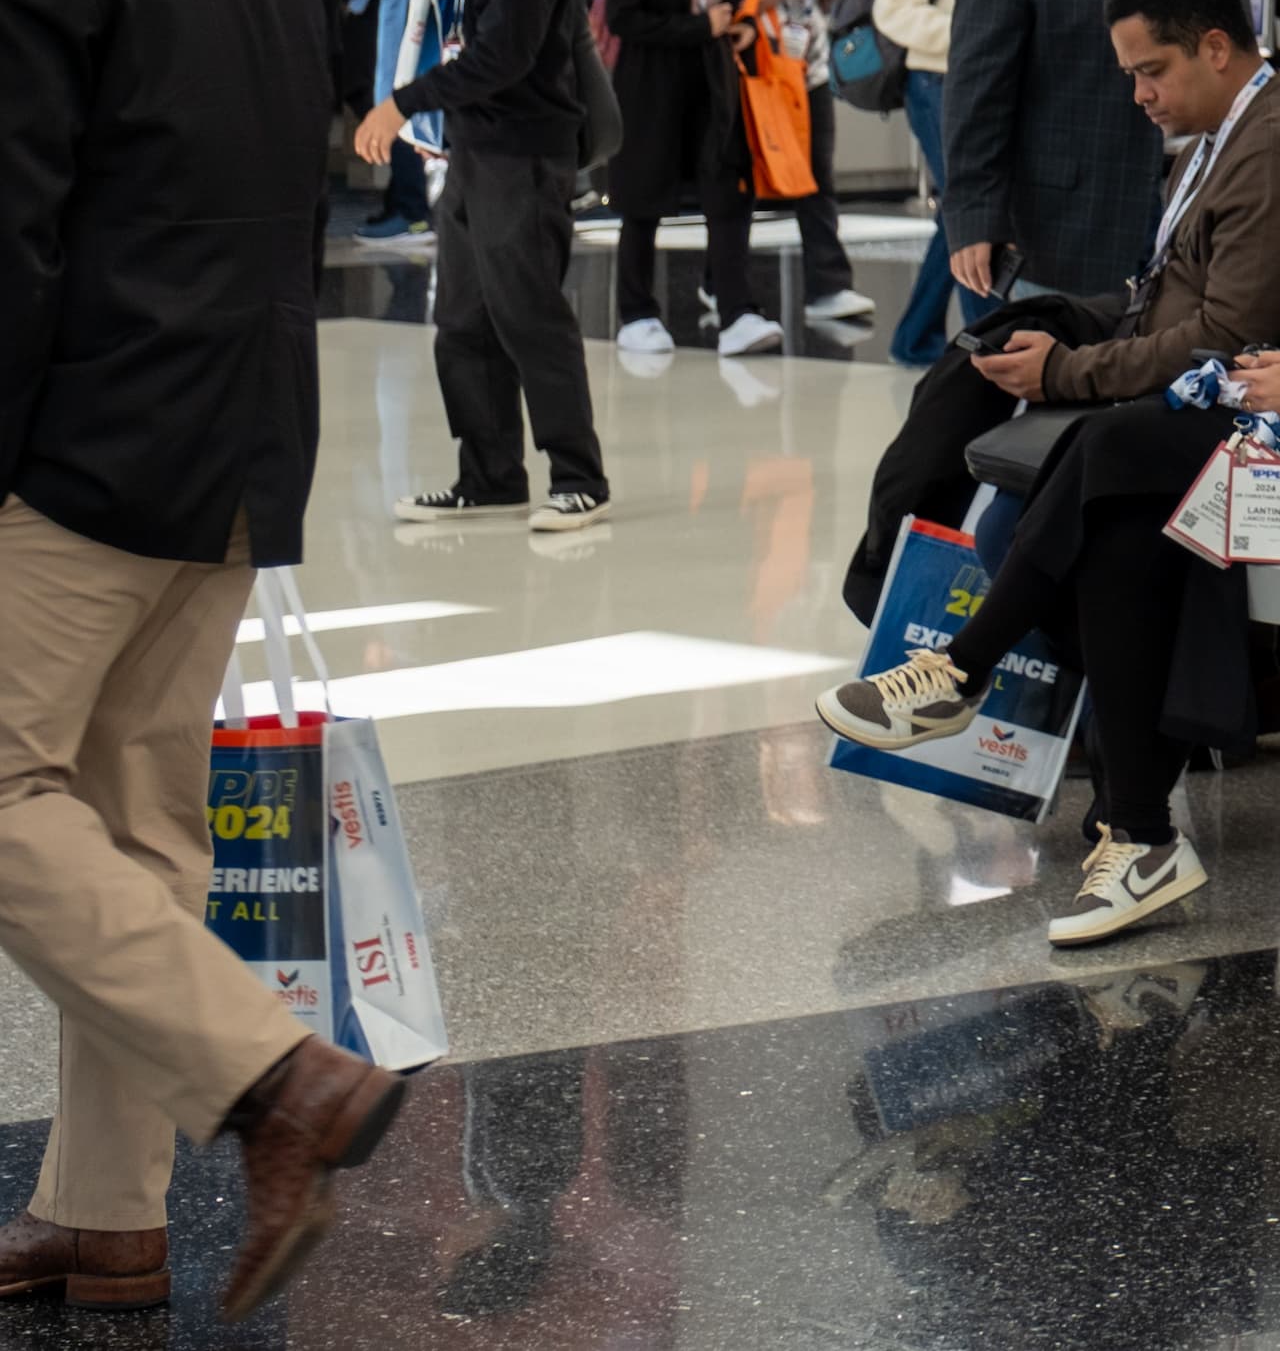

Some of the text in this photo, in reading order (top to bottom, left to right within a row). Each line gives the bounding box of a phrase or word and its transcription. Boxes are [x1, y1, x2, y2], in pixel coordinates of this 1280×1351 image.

[977, 735, 1029, 762] vestis
[334, 780, 363, 850] vestis
[232, 901, 280, 922] ALL
[353, 934, 393, 990] ISI
